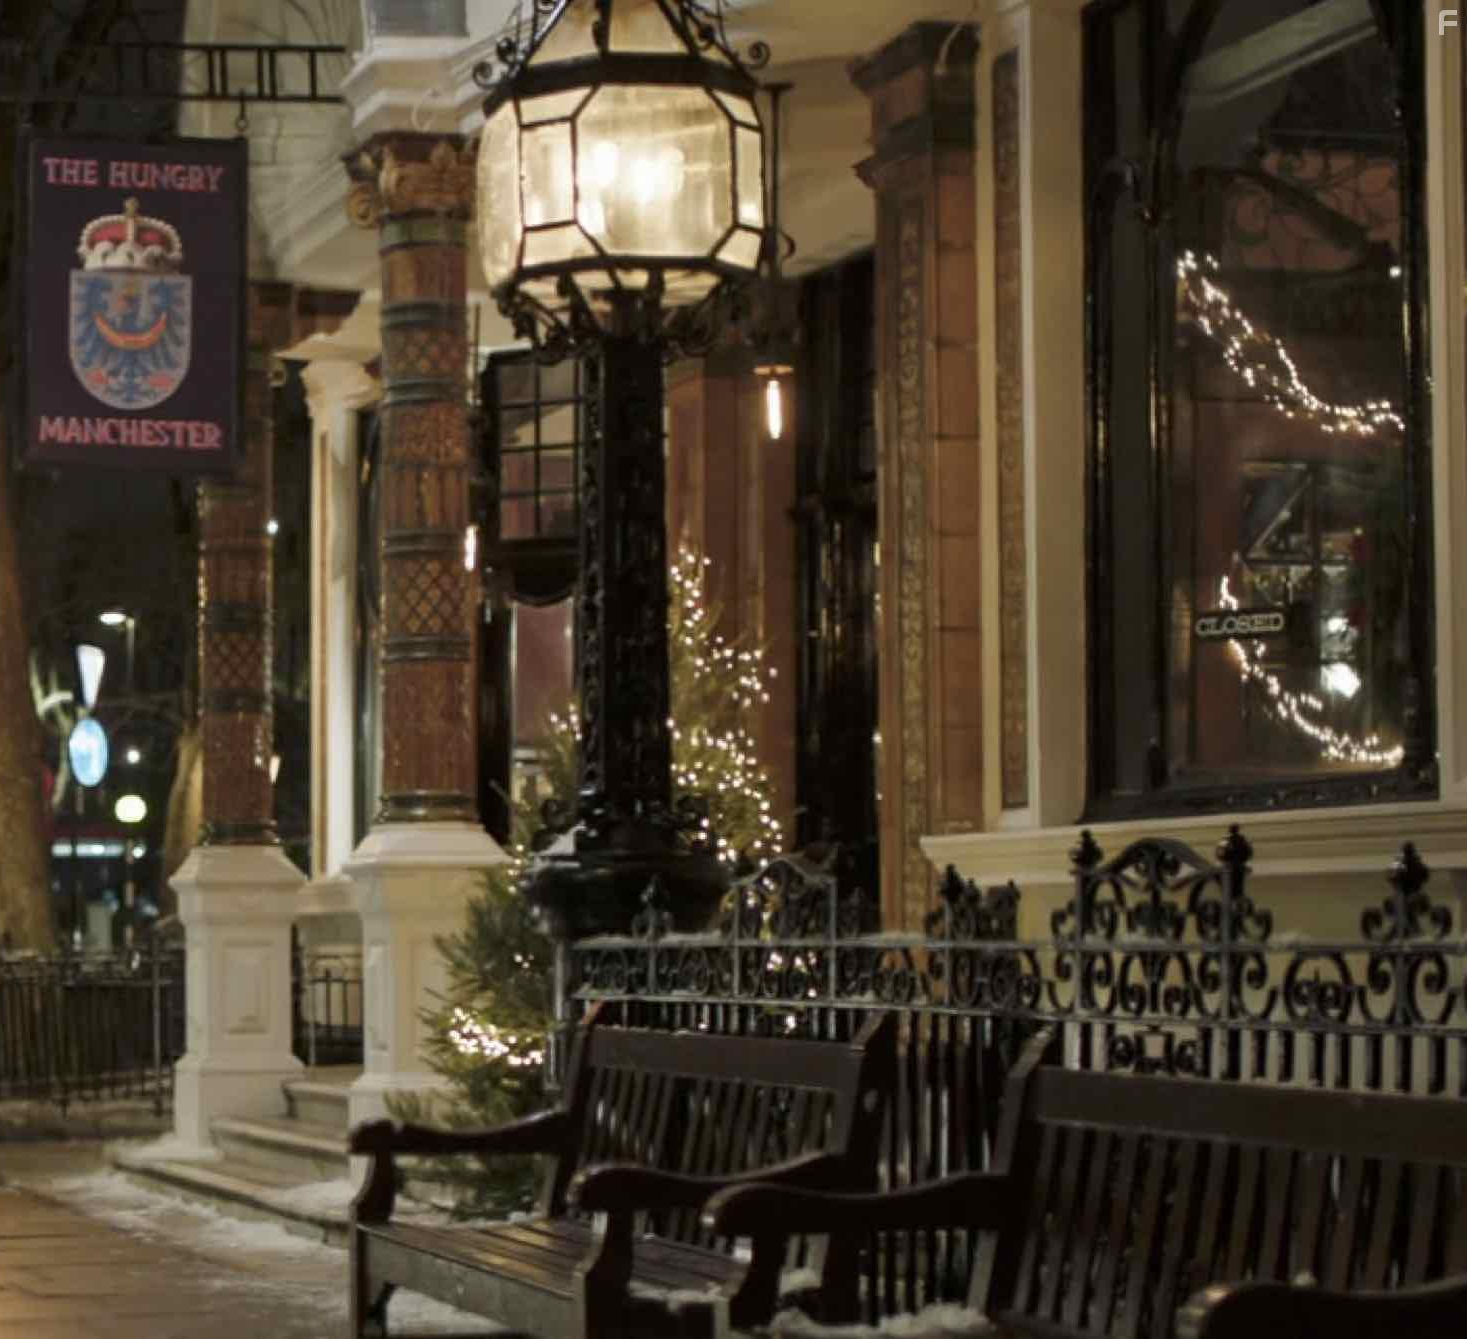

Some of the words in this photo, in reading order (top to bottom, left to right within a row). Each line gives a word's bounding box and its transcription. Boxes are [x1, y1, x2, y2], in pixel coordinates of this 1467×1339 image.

[42, 156, 99, 186] THE
[107, 159, 225, 192] HUNGRY
[37, 414, 223, 450] MANCHESTER
